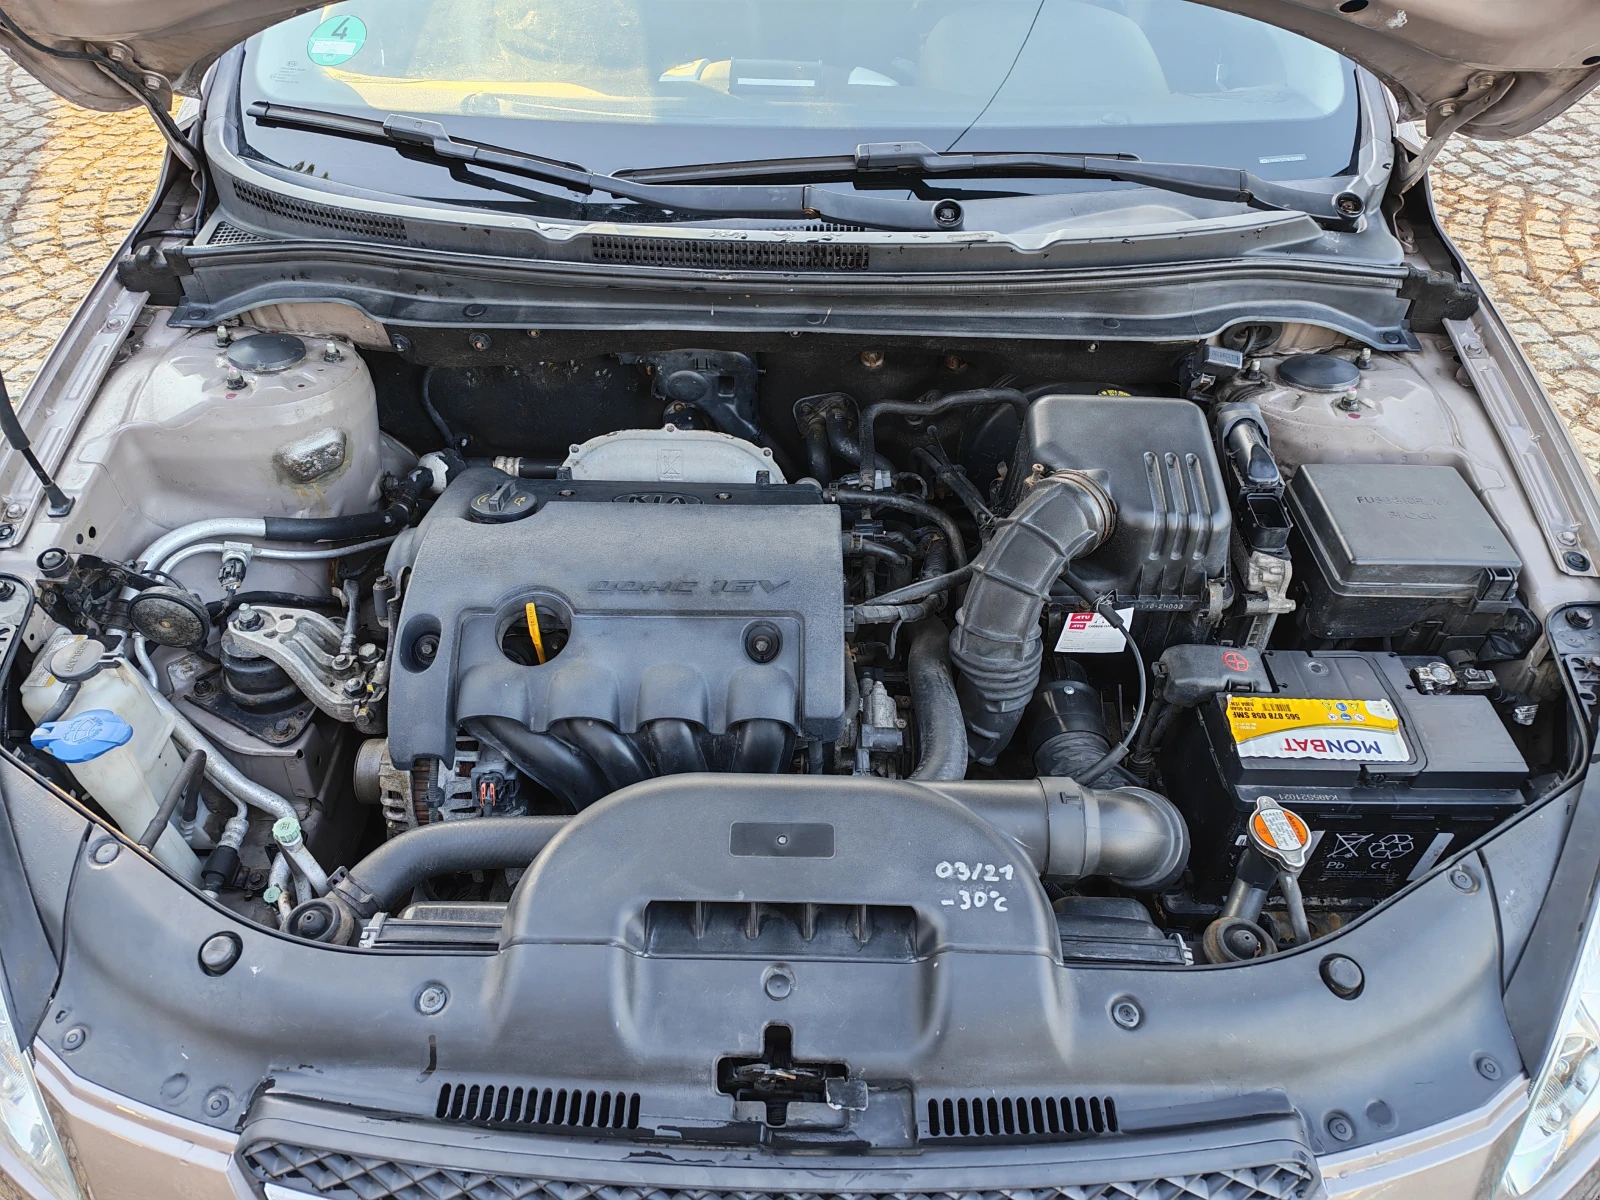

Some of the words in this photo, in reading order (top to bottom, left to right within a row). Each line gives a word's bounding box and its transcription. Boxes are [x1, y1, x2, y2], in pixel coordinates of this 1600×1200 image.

[331, 17, 351, 40] 4
[587, 580, 699, 593] DOHC
[710, 580, 791, 593] 16V
[64, 641, 90, 672] COOLANT
[1233, 711, 1250, 719] SMF
[1284, 738, 1383, 755] MONBAT
[936, 861, 1013, 881] 03/21
[1326, 861, 1345, 869] Pb
